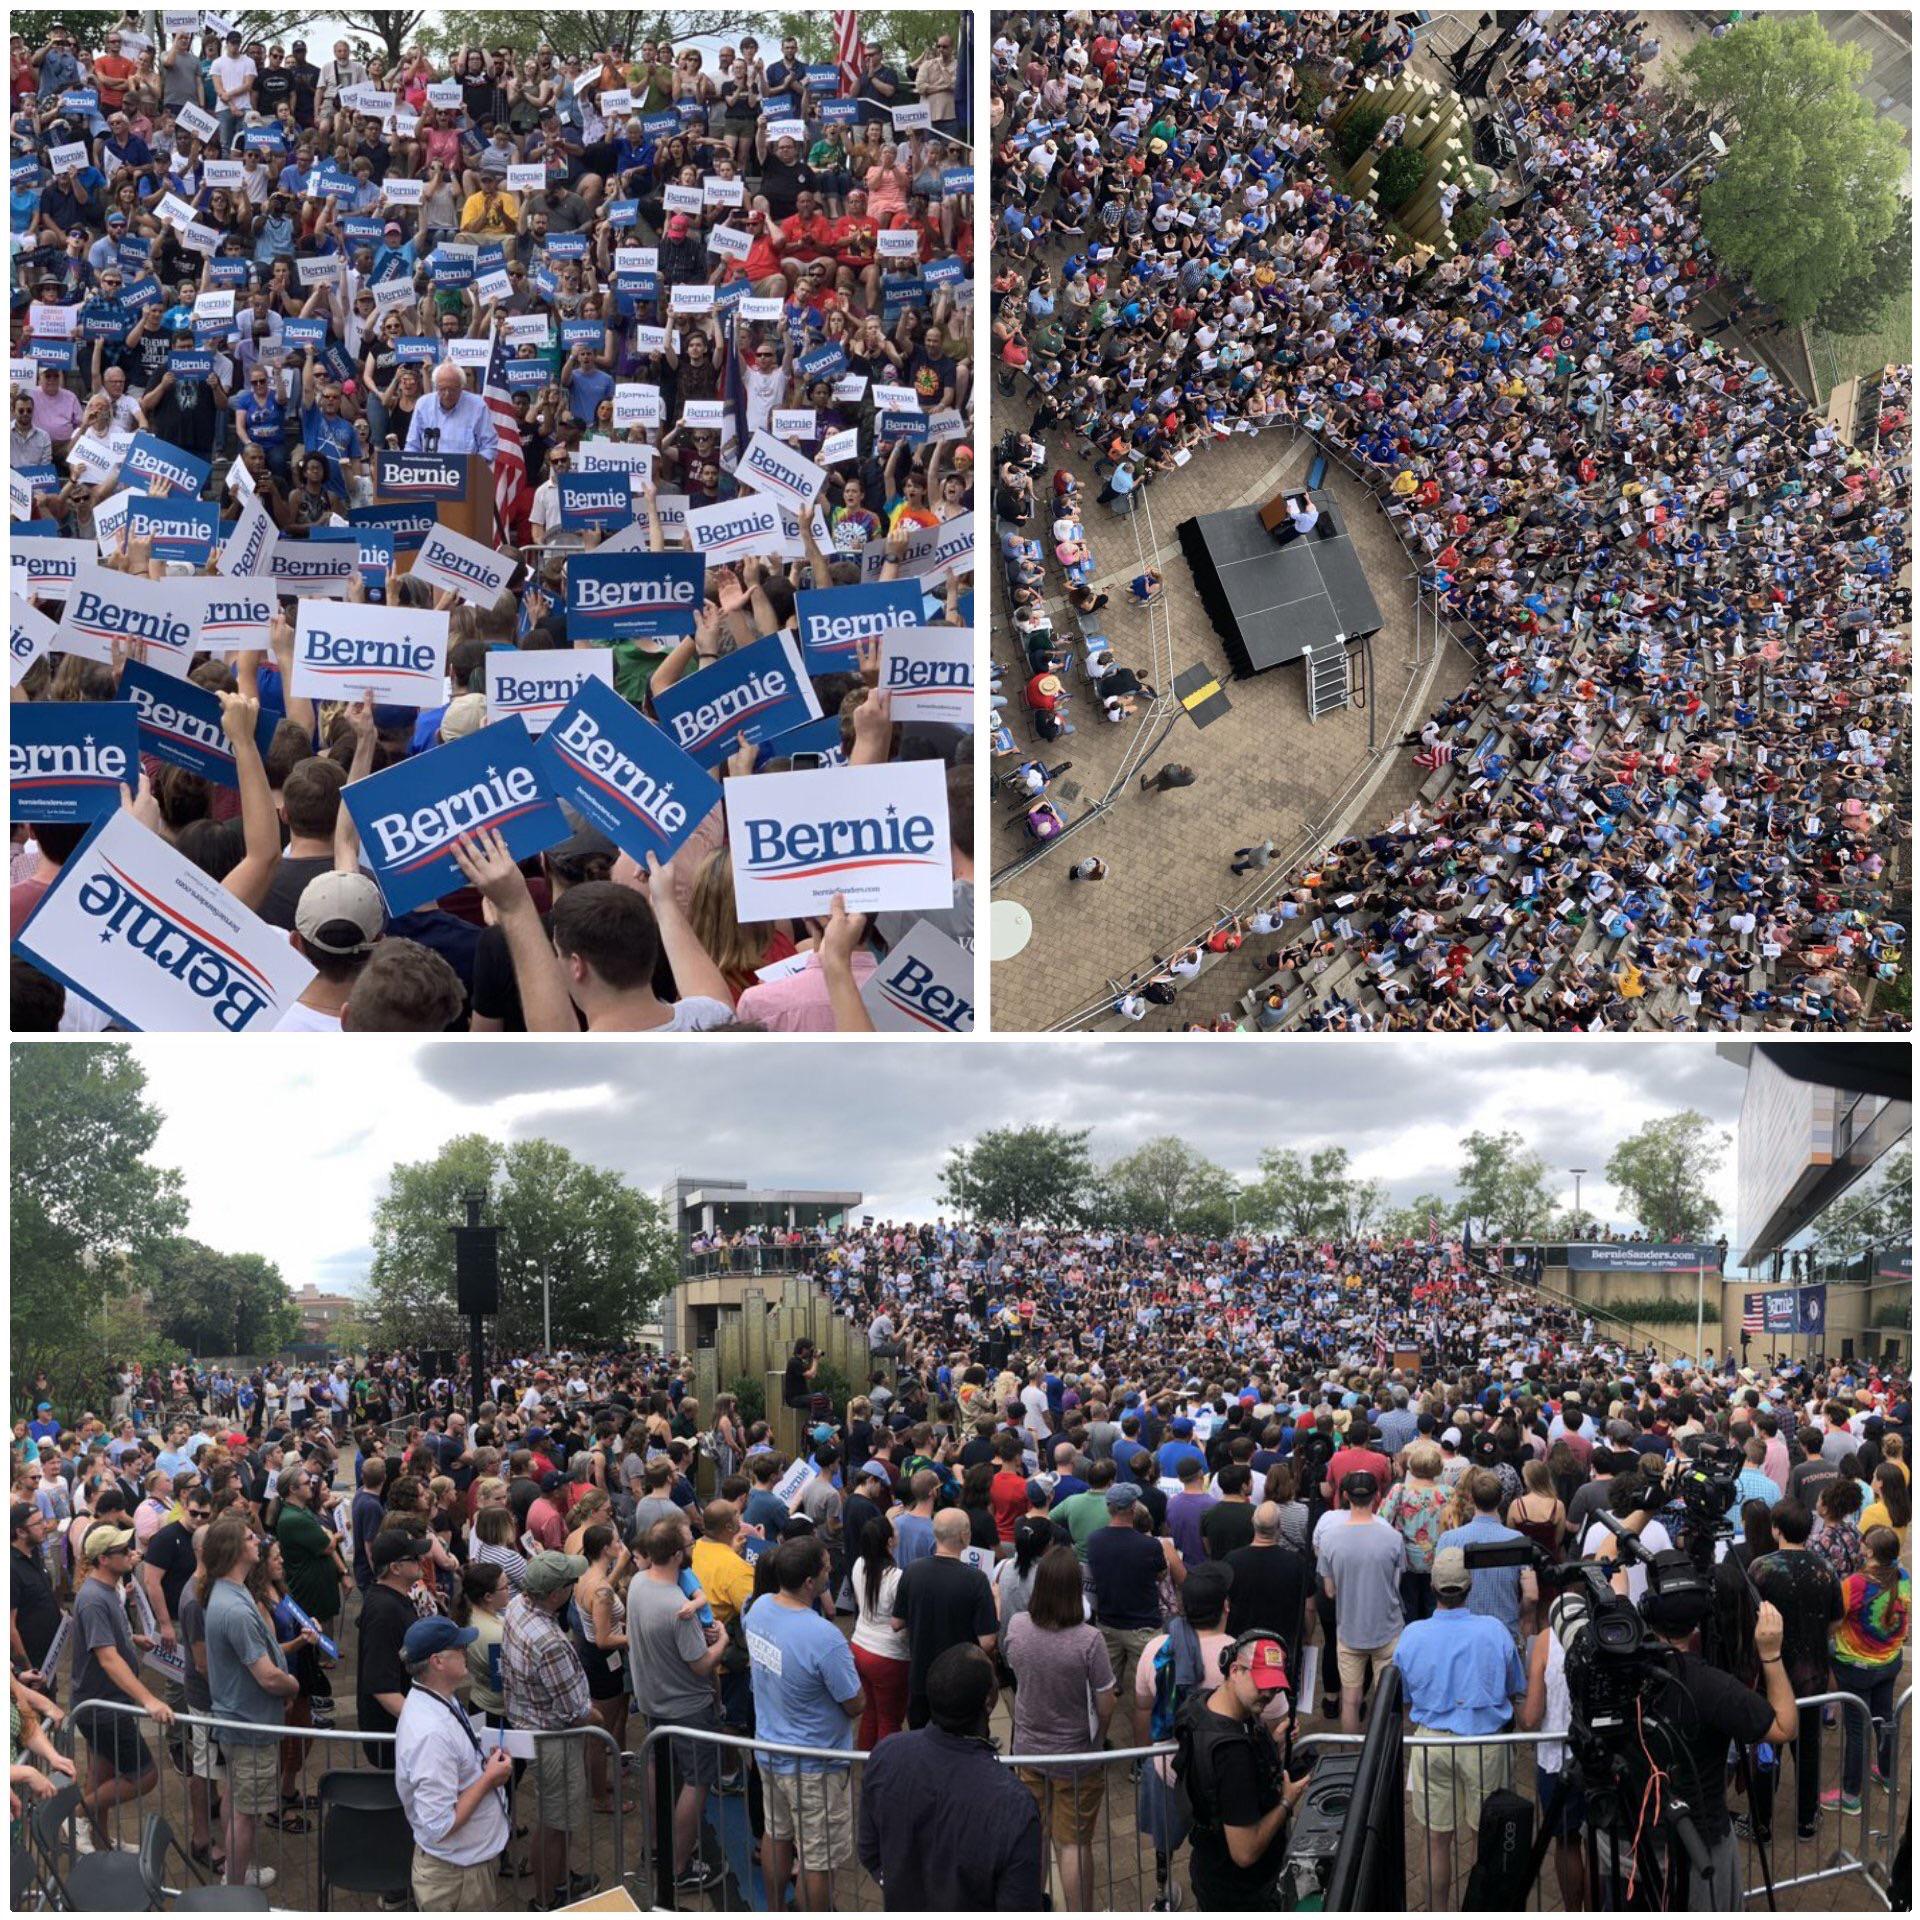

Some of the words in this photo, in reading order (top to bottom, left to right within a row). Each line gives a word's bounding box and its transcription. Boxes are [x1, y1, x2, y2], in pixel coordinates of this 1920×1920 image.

[166, 16, 197, 25] Bernie
[806, 72, 836, 80] Bernie
[430, 91, 460, 100] Bernie
[823, 106, 856, 114] Bernie
[184, 108, 213, 131] Bernie
[644, 118, 676, 131] Bernie
[247, 133, 280, 144] Bernie
[53, 150, 84, 163] Bernie
[207, 167, 240, 177] Bernie
[510, 172, 543, 181] Bernie
[321, 179, 355, 192] Bernie
[386, 186, 420, 195] Bernie
[667, 193, 700, 204] Bernie
[707, 187, 740, 198] Bernie
[346, 224, 382, 236] Bernie
[548, 241, 583, 250] Bernie
[714, 232, 748, 250] Bernie
[880, 238, 914, 248] Bernie
[210, 264, 244, 273] Bernie
[301, 264, 336, 276] Bernie
[435, 269, 471, 279] Bernie
[925, 265, 960, 280] Bernie
[618, 279, 654, 289] Bernie
[121, 284, 157, 306] Bernie
[377, 286, 412, 300] Bernie
[674, 293, 711, 302] Bernie
[886, 288, 922, 299] Bernie
[86, 318, 122, 330] Bernie
[285, 325, 323, 337] Bernie
[563, 328, 600, 339] Bernie
[32, 345, 70, 359] Bernie
[398, 343, 436, 353] Bernie
[451, 345, 489, 356] Bernie
[171, 357, 211, 370] Bernie
[805, 350, 843, 373] Bernie
[10, 367, 34, 379] rnie
[508, 368, 547, 381] Bernie
[876, 390, 914, 403] Bernie
[616, 405, 657, 417] Bernie
[885, 419, 926, 431] Bernie
[75, 444, 111, 470] Bernie
[129, 447, 198, 491] Bernie
[584, 455, 647, 474] Bernie
[383, 463, 460, 485] Bernie
[748, 446, 813, 497] Bernie
[563, 489, 626, 508] Bernie
[132, 513, 212, 539] Bernie
[695, 512, 775, 545] Bernie
[231, 512, 268, 577] Bernie
[358, 544, 389, 566] nie
[270, 555, 352, 576] Bernie
[425, 539, 500, 588] Bernie
[575, 574, 695, 607] Bernie
[204, 597, 270, 624] rnie
[73, 590, 191, 647] Bernie
[808, 603, 918, 642] Bernie
[304, 629, 436, 672] Bernie
[888, 655, 974, 689] Bern
[671, 670, 788, 746] Bernie
[10, 733, 126, 777] ernie
[557, 709, 687, 833] Bernie
[370, 764, 538, 862] Bernie
[744, 803, 935, 865] Bernie
[79, 872, 268, 1032] Bernie
[1592, 1249, 1695, 1260] BernieSanders.com
[780, 1467, 808, 1499] Bernie
